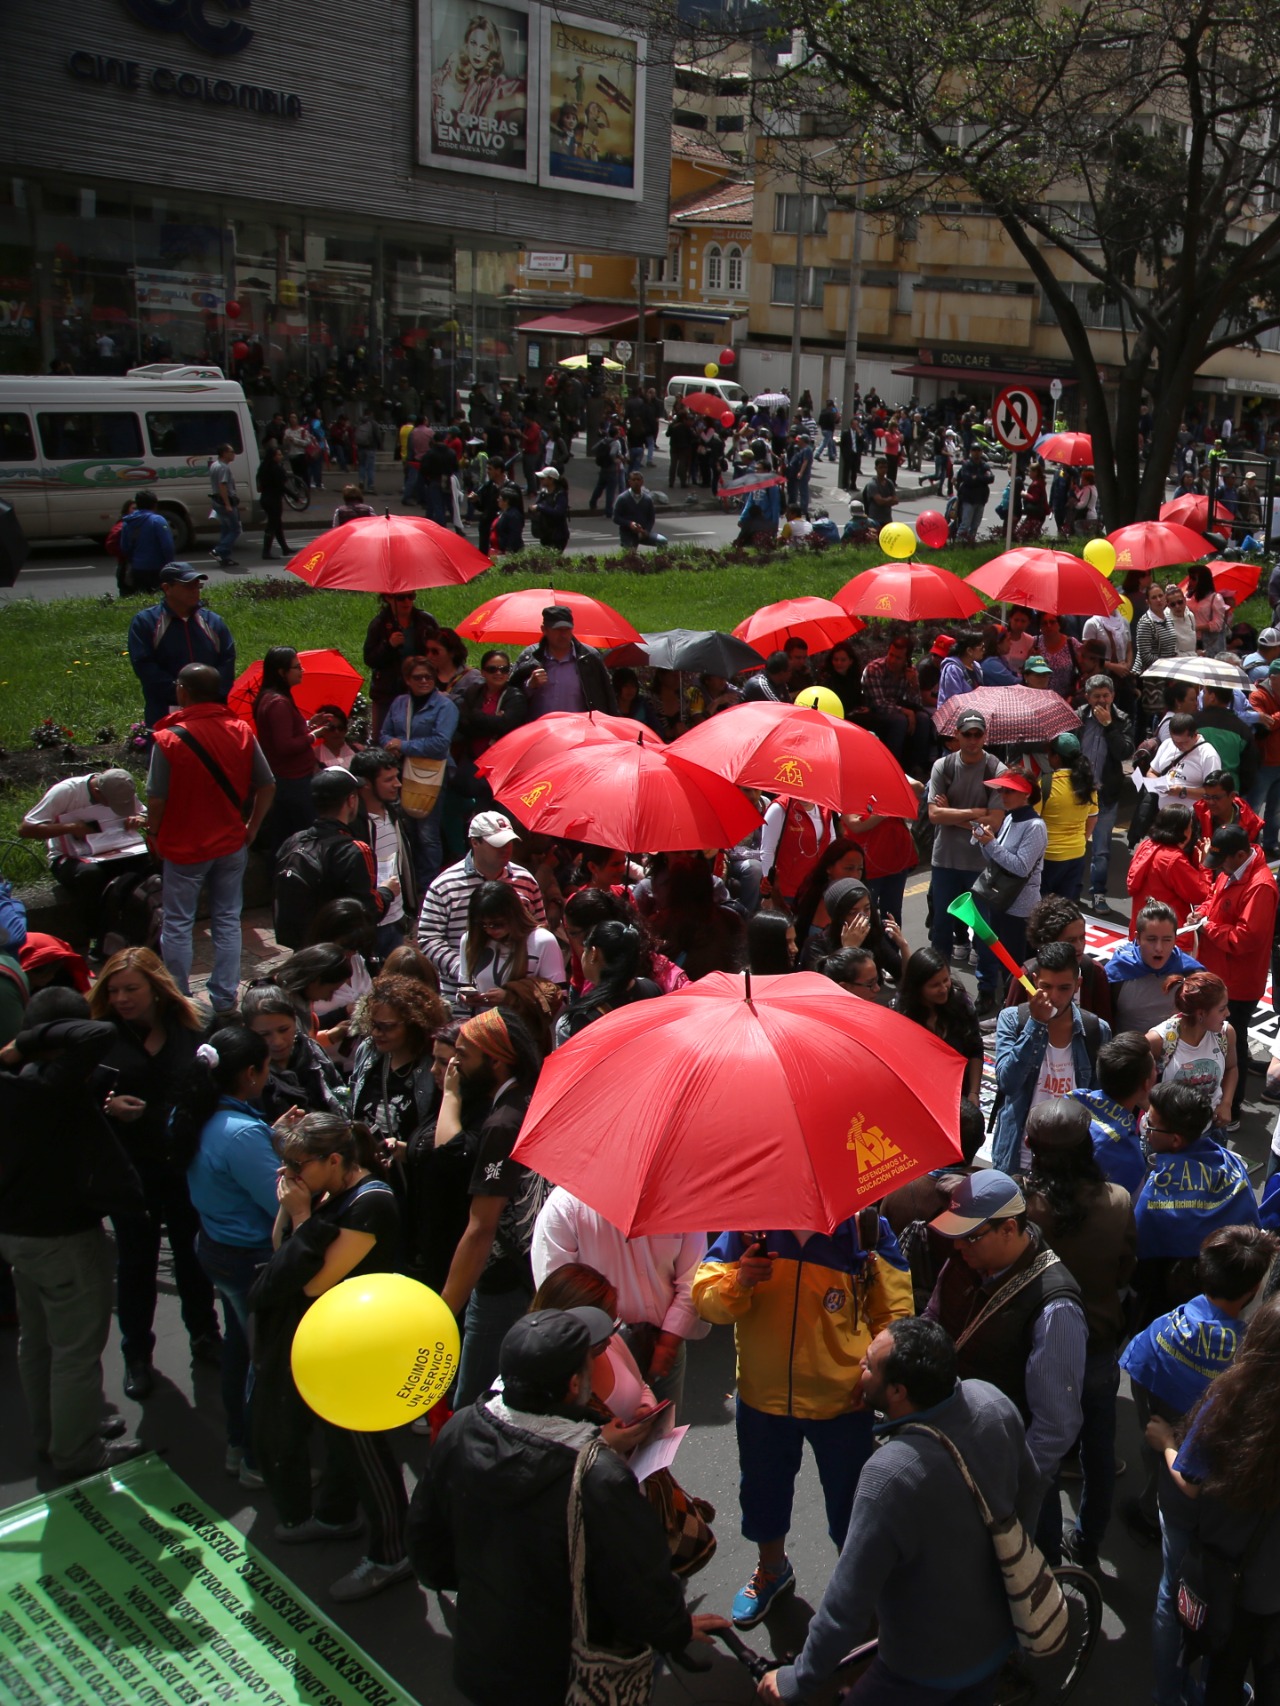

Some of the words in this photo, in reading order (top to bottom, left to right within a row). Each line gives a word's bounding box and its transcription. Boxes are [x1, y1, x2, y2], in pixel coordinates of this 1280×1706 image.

[66, 51, 140, 89] CINE
[150, 67, 302, 119] COLOMBIA
[436, 109, 453, 124] 10
[457, 112, 519, 136] OPERAS
[438, 125, 464, 141] EN
[464, 130, 505, 149] VIVO
[438, 141, 458, 151] DESDE
[460, 143, 480, 154] NUEVA
[482, 147, 499, 156] YORK
[941, 353, 962, 365] DON
[964, 354, 991, 367] CAFÉ
[855, 1126, 902, 1174] ADE
[856, 1171, 892, 1195] EDUCACIÓN
[891, 1158, 919, 1176] PÚBLICA
[858, 1158, 899, 1184] DEFENDEMOS
[899, 1154, 909, 1162] LA
[396, 1347, 430, 1399] EXIGIMOS
[406, 1394, 424, 1408] UN
[420, 1341, 445, 1393] SERVICIO
[422, 1392, 437, 1406] DE
[435, 1353, 453, 1390] SALUD
[171, 1502, 246, 1563] PRESENTES
[105, 1530, 145, 1564] PLANTA
[136, 1560, 156, 1576] LA
[146, 1570, 169, 1588] DE
[36, 1574, 59, 1590] NO
[81, 1579, 103, 1596] LA
[179, 1552, 243, 1614] TEMPORALES
[236, 1556, 311, 1634] PRESENTES,
[51, 1585, 78, 1607] QUE
[92, 1590, 115, 1608] DE
[159, 1583, 205, 1629] LABORAL
[64, 1603, 91, 1624] LOS
[35, 1619, 86, 1662] BOGOTÁ
[79, 1620, 104, 1640] DE
[18, 1640, 42, 1660] DE
[103, 1603, 185, 1686] DESVINCULADOS
[235, 1607, 329, 1699] ADMINISTRATIVOS
[73, 1657, 98, 1677] DE
[193, 1658, 216, 1678] LA
[196, 1622, 270, 1694] CONTINUIDAD
[129, 1677, 148, 1690] Y
[206, 1672, 224, 1684] A
[174, 1680, 203, 1705] SER
